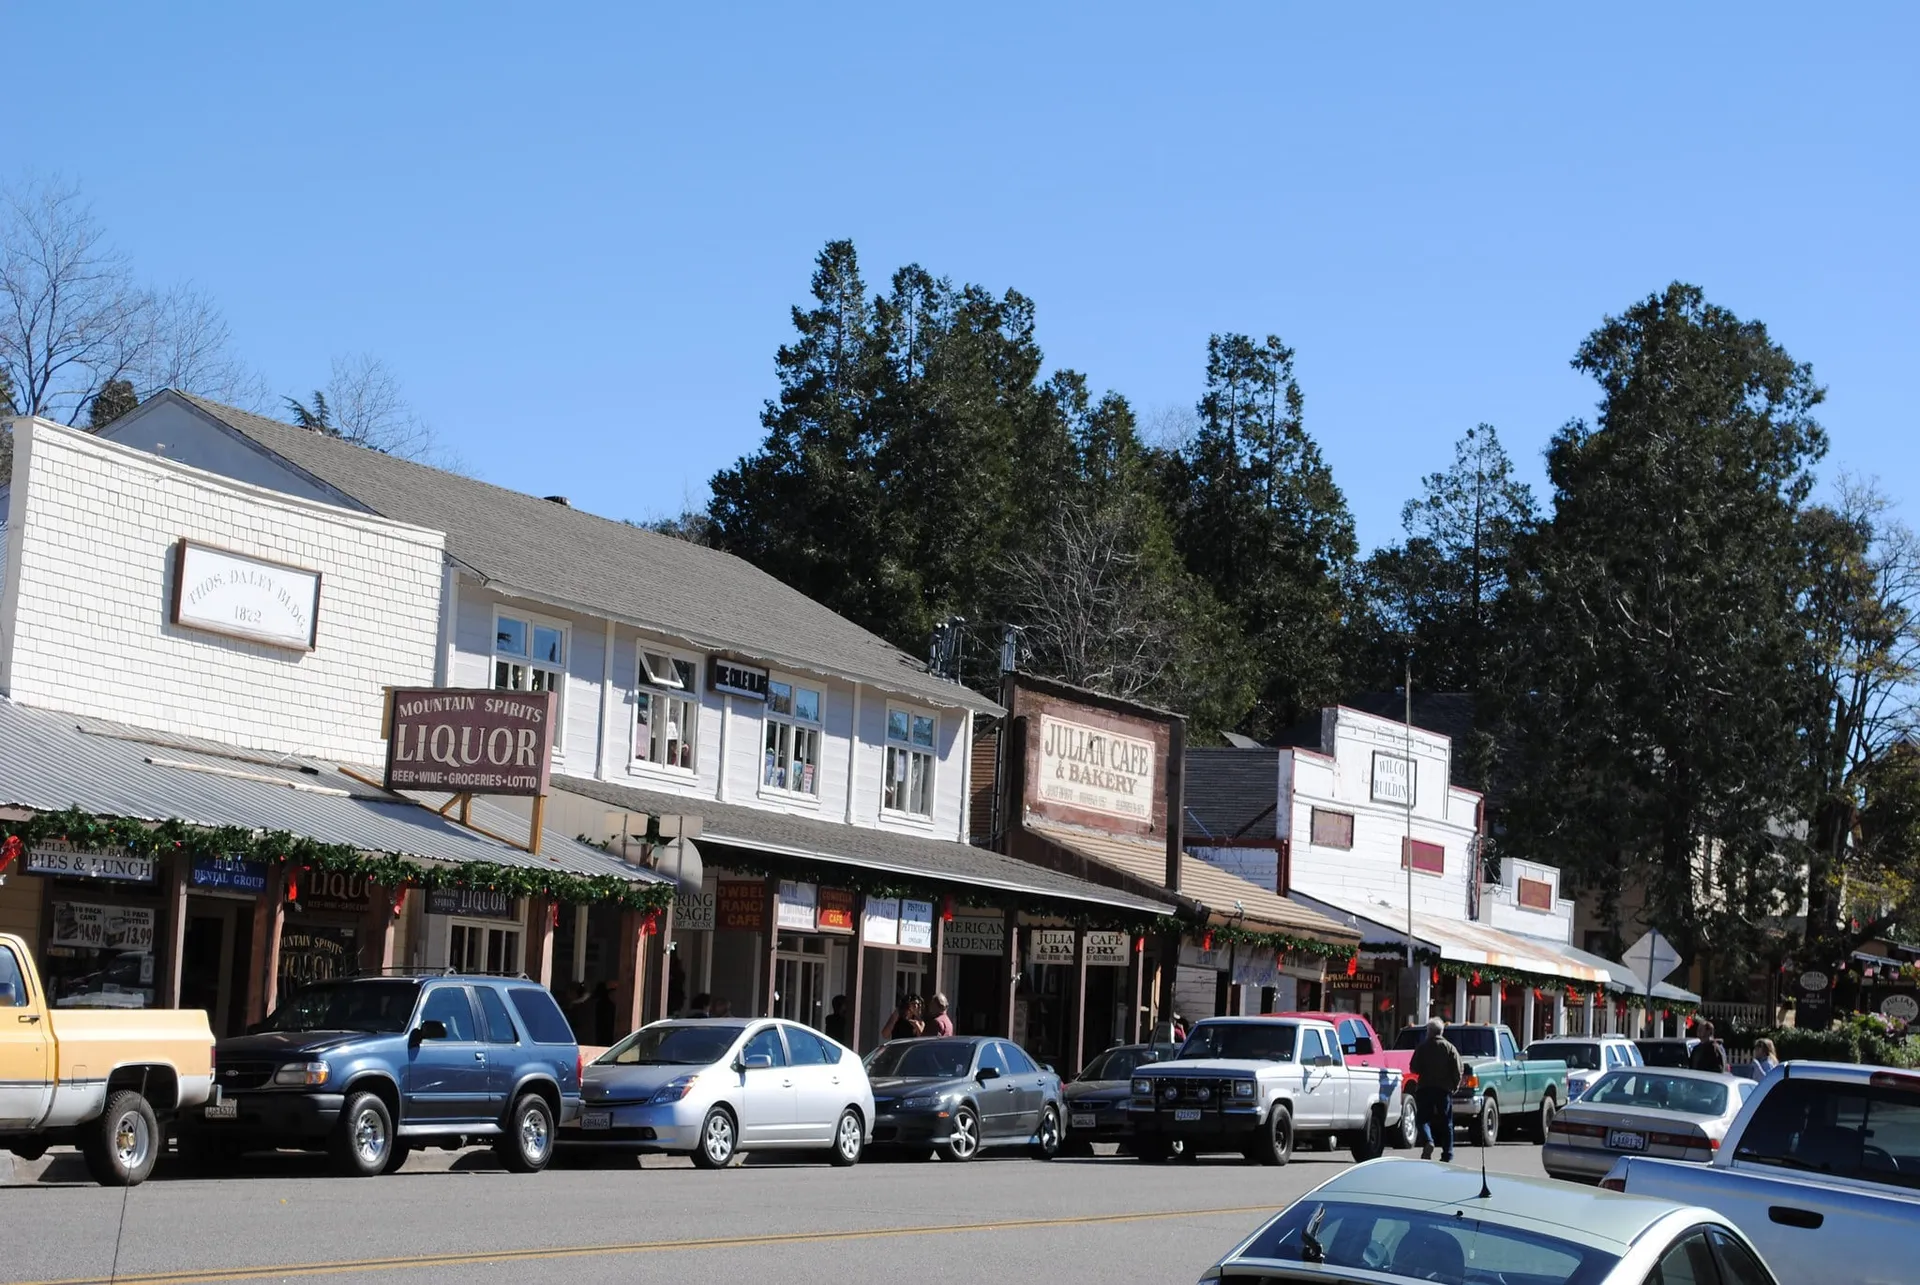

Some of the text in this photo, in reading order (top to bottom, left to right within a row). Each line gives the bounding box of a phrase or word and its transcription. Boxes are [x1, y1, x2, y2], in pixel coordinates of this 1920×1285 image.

[229, 569, 276, 592] DALEY
[235, 605, 262, 623] 1872
[399, 697, 544, 723] MOUNTAIN SPIRITS
[395, 724, 537, 768] LIQUOR
[1045, 723, 1149, 777] JULIAN CAFE
[392, 770, 537, 788] BEER WINE GROCERIES LOTTO
[1056, 760, 1137, 795] & BAKERY
[28, 853, 151, 877] PIES & LUNCH
[194, 869, 265, 888] DENTAL GROUP
[310, 871, 371, 899] LIQU
[462, 890, 507, 911] LIQUOR
[675, 907, 712, 921] SAGE
[728, 913, 761, 926] CAFE
[944, 921, 1004, 935] MERICAN
[314, 937, 344, 955] SPIRITS
[943, 937, 1004, 951] ARDENER
[1037, 932, 1123, 946] JULIA CAFE
[1886, 996, 1914, 1009] JULIAN
